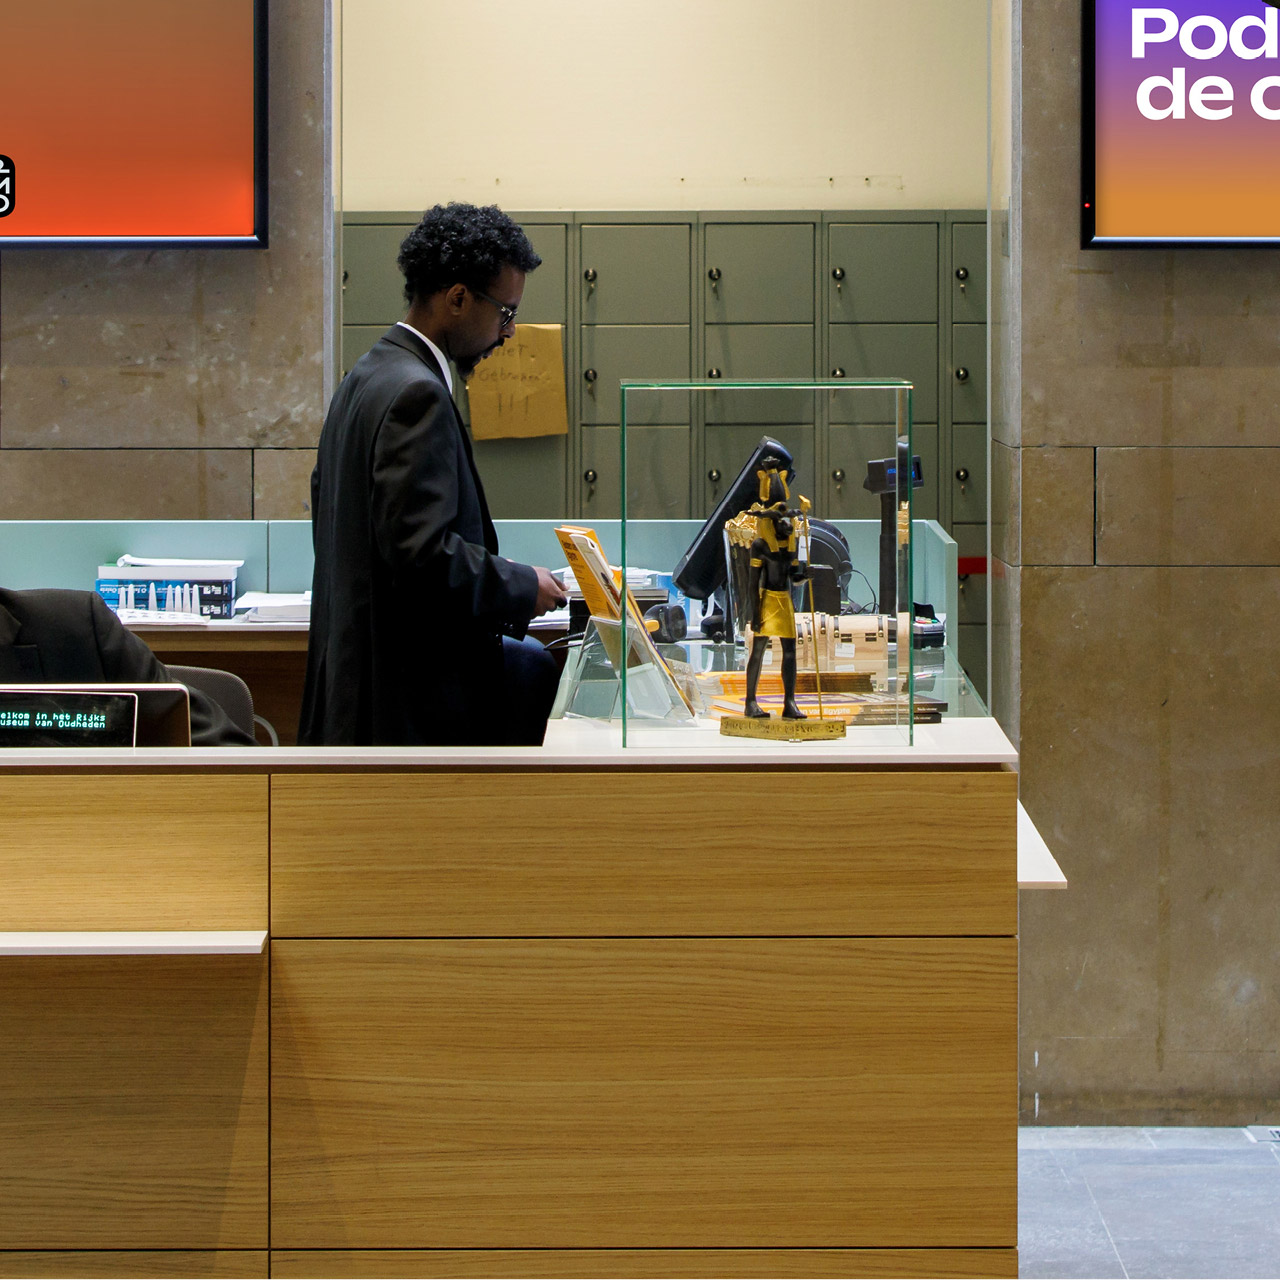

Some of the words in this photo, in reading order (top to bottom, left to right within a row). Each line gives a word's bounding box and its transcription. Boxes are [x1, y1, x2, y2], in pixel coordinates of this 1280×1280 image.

[1135, 66, 1235, 122] de
[823, 708, 851, 716] Egypte
[36, 712, 48, 720] in
[76, 713, 106, 722] Rijks
[58, 720, 106, 728] Oudheden
